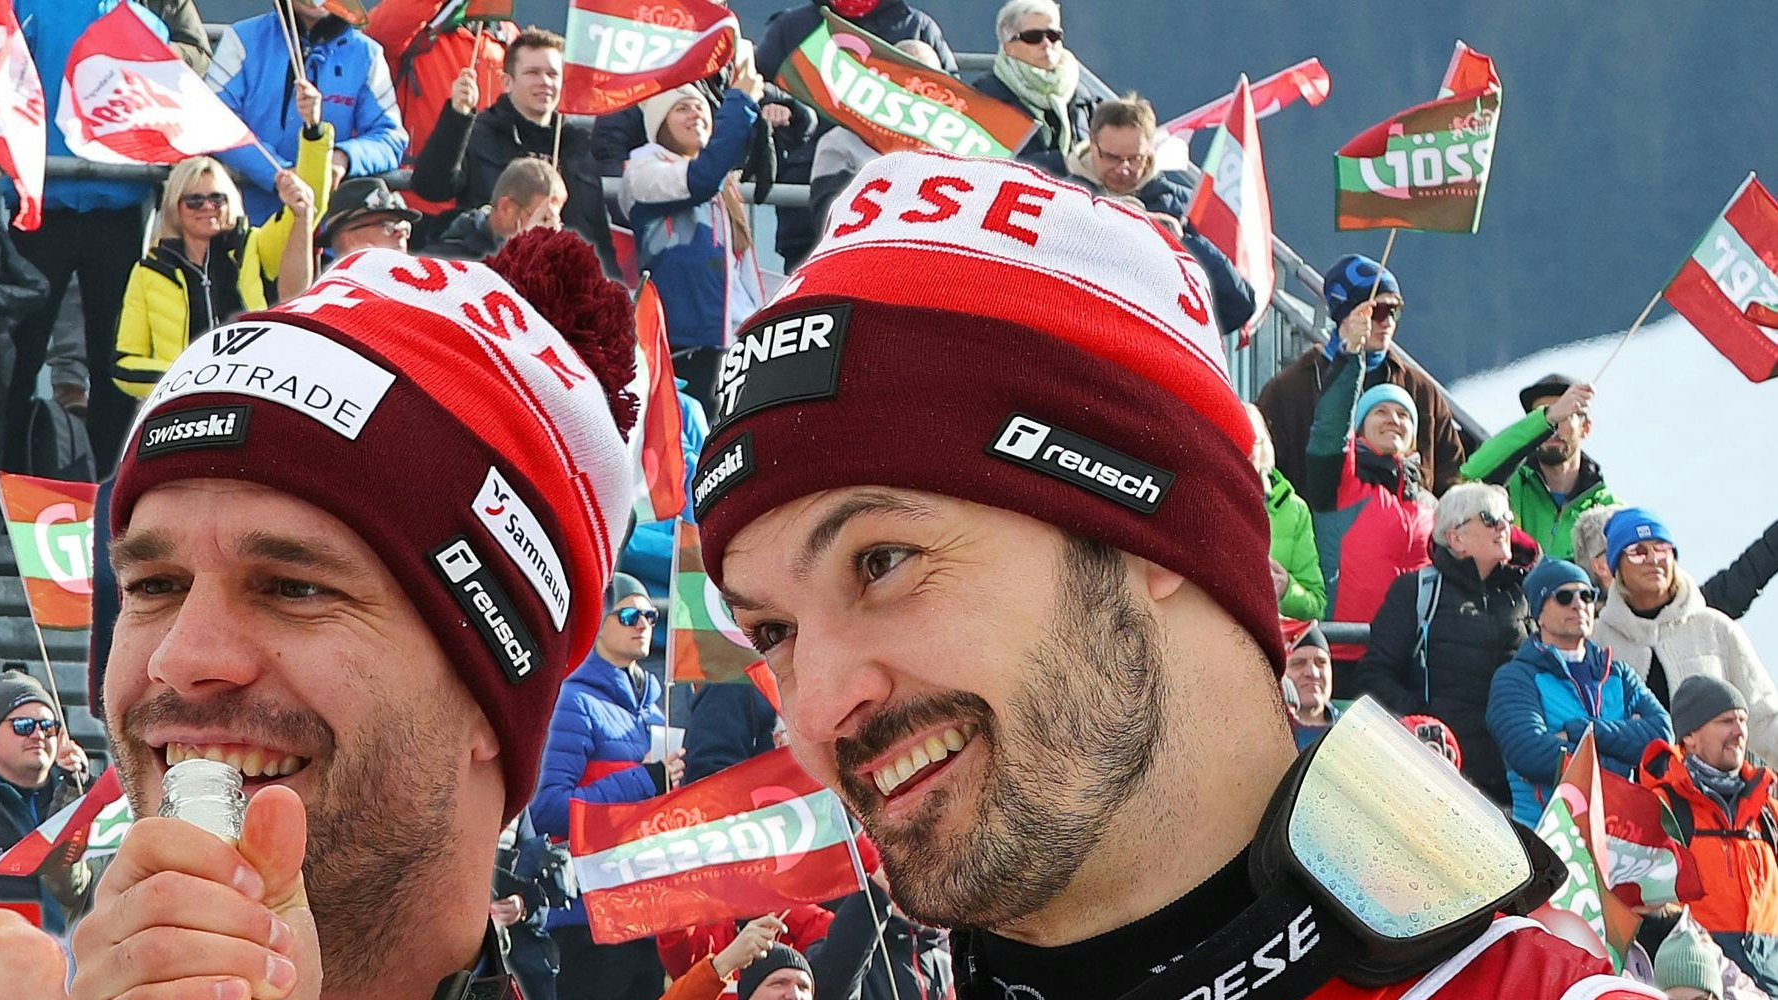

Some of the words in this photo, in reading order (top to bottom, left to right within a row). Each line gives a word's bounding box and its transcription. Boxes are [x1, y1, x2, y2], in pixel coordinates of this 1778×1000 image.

[821, 32, 991, 157] Gösser
[1359, 132, 1490, 199] Göss
[145, 363, 362, 430] RCOTRADE
[145, 412, 237, 447] swissski
[1042, 444, 1161, 504] reusch
[504, 513, 567, 614] Samnaun
[463, 580, 532, 678] reusch
